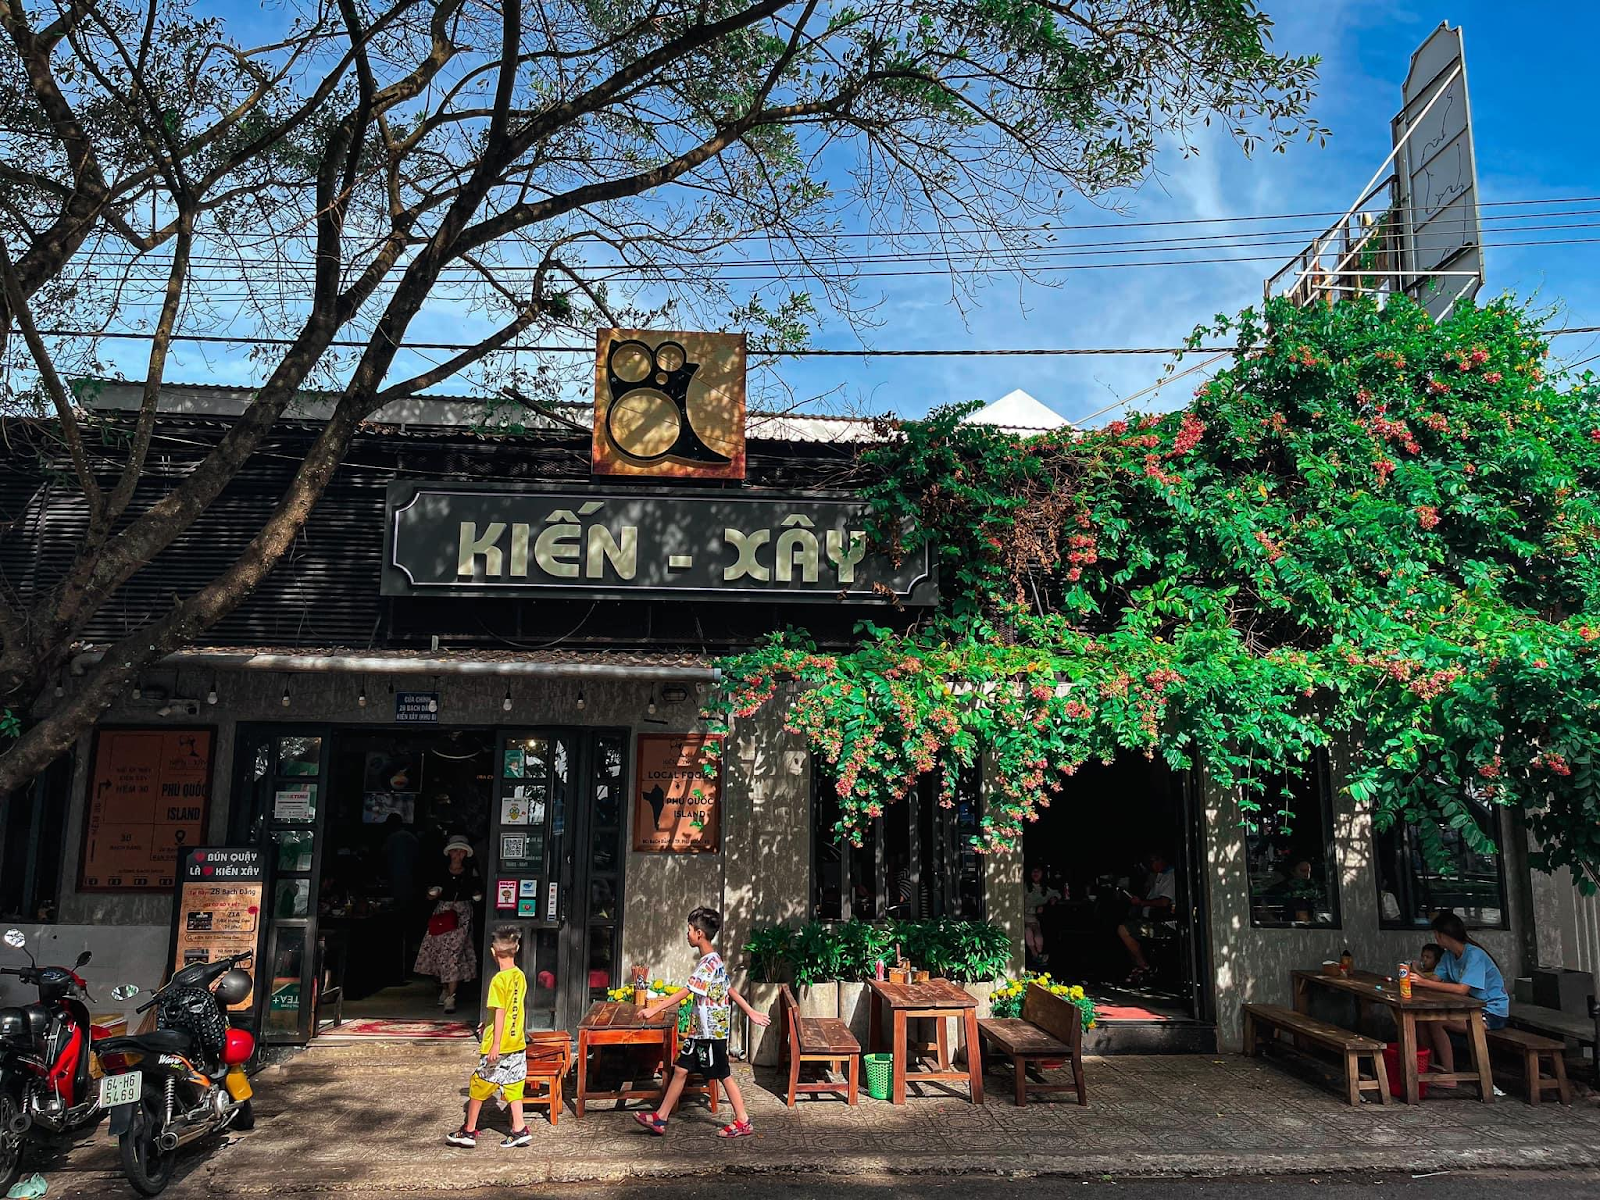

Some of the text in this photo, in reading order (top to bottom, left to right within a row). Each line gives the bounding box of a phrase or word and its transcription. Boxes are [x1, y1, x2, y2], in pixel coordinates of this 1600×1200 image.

[457, 502, 638, 580] KIẾN
[723, 513, 867, 583] XÂY
[167, 807, 200, 820] ISLAND
[207, 851, 257, 863] BÚN QUẬY
[189, 864, 259, 876] LÀ KIẾN XÂY
[107, 1075, 135, 1090] 64-H6
[106, 1088, 134, 1104] 5469
